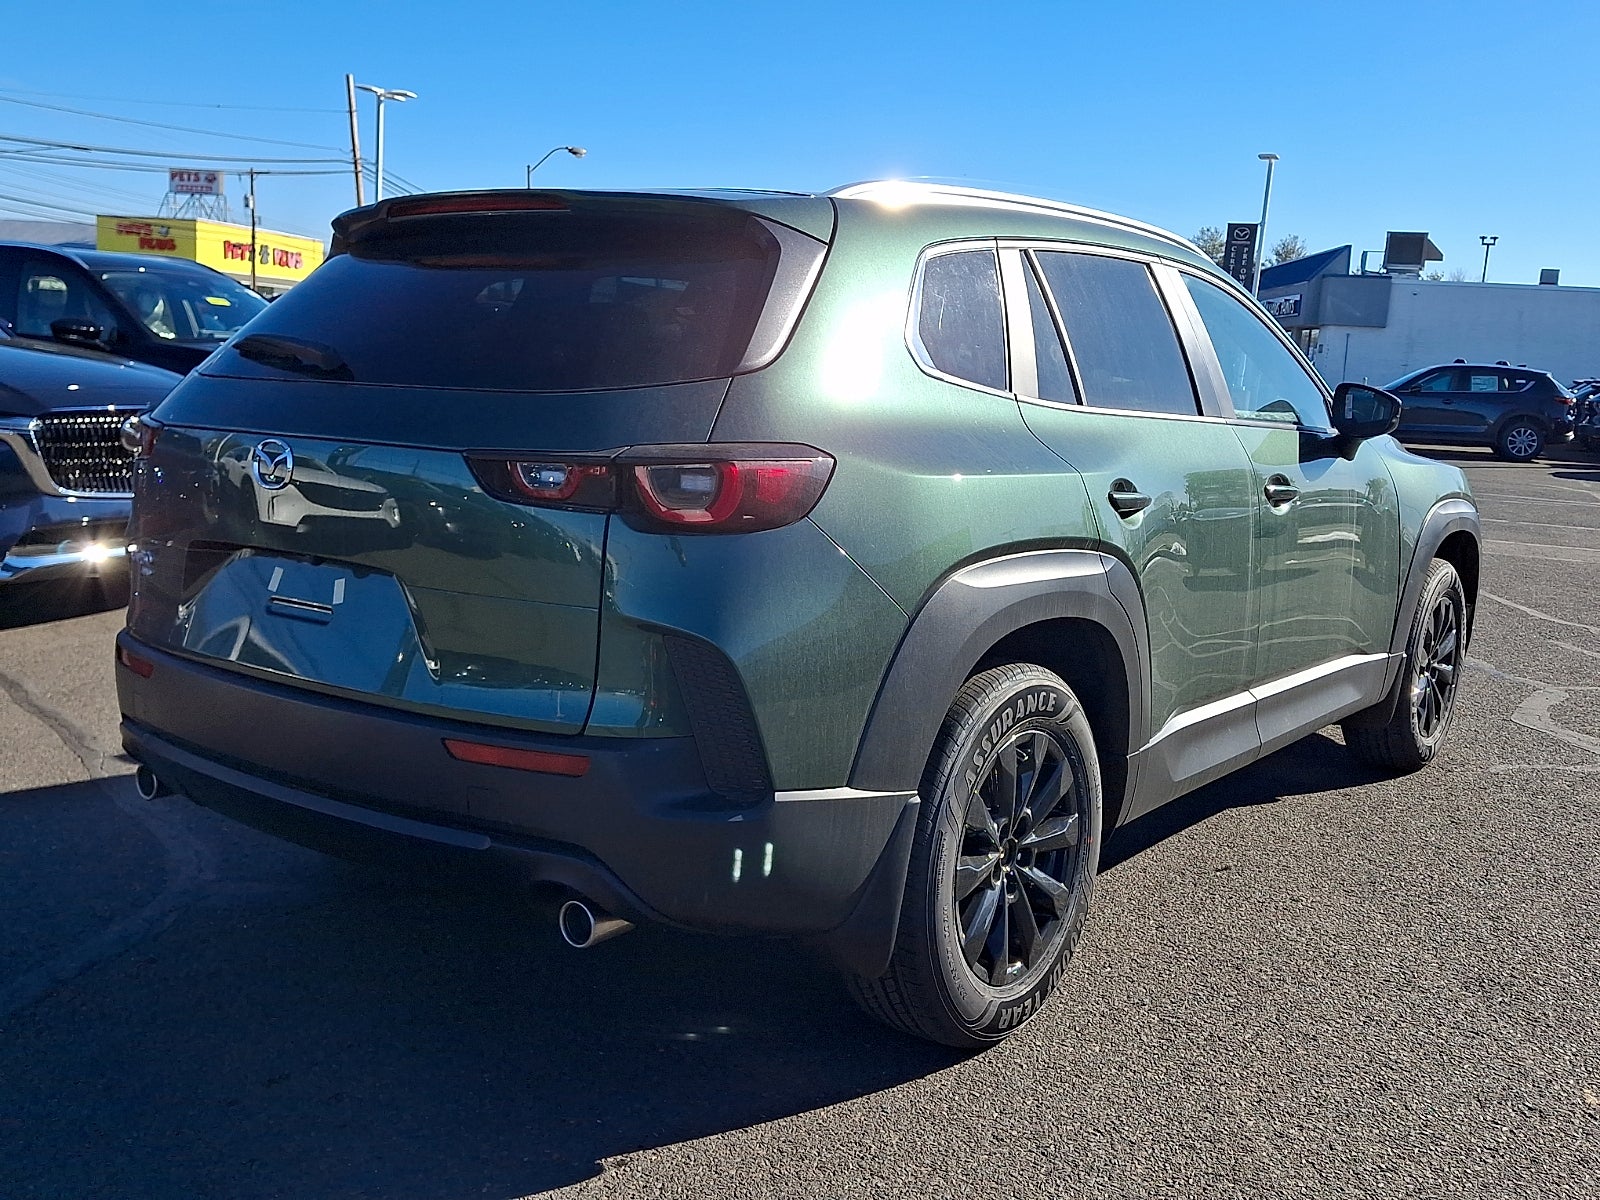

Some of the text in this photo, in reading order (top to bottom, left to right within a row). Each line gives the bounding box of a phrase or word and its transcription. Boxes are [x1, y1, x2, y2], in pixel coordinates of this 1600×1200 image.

[171, 170, 200, 182] PETS
[272, 247, 303, 269] PLUS
[964, 691, 1058, 791] ASSURANCE
